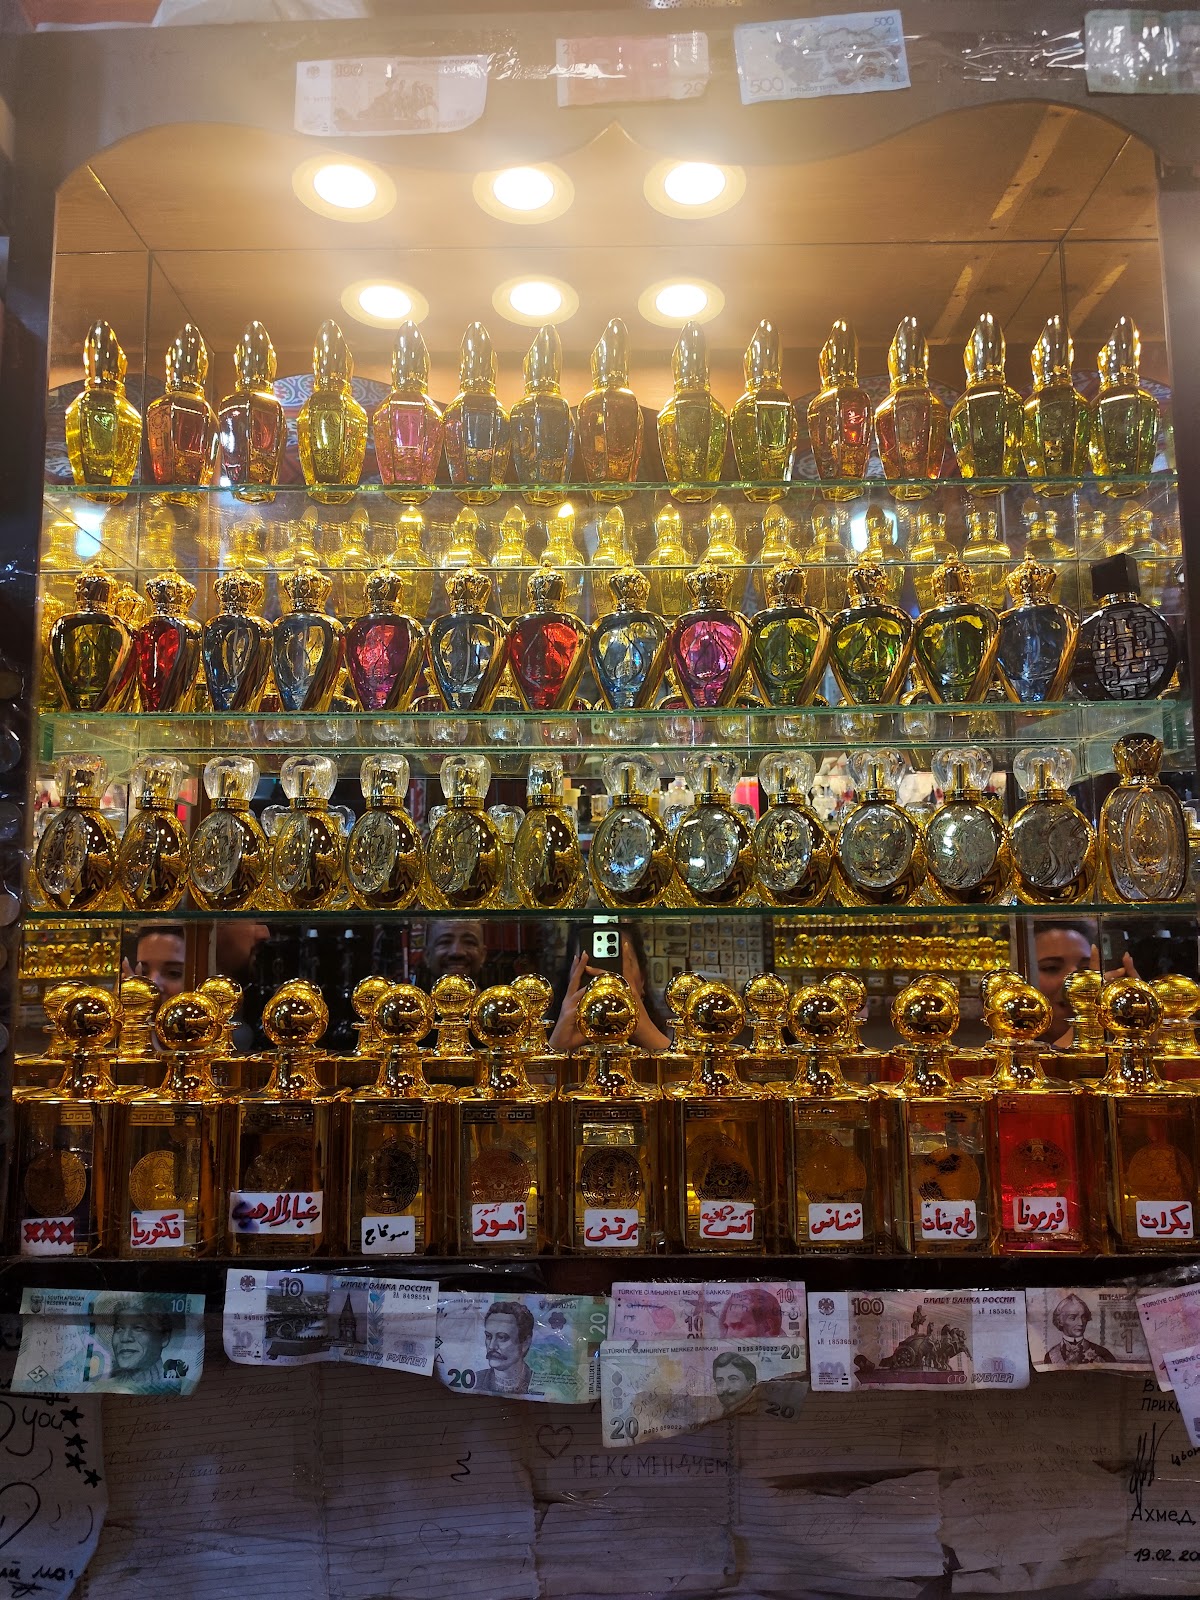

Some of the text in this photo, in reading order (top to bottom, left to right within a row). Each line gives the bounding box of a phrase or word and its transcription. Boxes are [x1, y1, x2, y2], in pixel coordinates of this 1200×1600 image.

[873, 16, 894, 26] 500
[562, 43, 579, 55] 20
[335, 63, 362, 77] 100
[683, 82, 704, 96] 20
[749, 78, 785, 94] 500
[279, 1276, 304, 1297] 10
[399, 1284, 433, 1293] РОССИИ
[618, 1288, 643, 1297] TÜRKİYE
[643, 1288, 681, 1297] CUMHURİYET
[682, 1289, 704, 1297] MERK
[776, 1288, 795, 1304] 10
[982, 1296, 1017, 1305] РОССИИ
[1142, 1297, 1168, 1309] TÜRKİYE
[171, 1299, 185, 1313] 10
[851, 1297, 884, 1317] 100
[590, 1312, 607, 1335] 20
[685, 1315, 703, 1333] 10
[1120, 1328, 1134, 1355] 1
[608, 1347, 632, 1356] TÜRKİYE
[632, 1347, 670, 1355] CUMHURİYET
[671, 1345, 694, 1353] MERKEZ
[780, 1344, 800, 1360] 20
[386, 1352, 428, 1368] РУБЛЕЙ
[1171, 1354, 1196, 1366] TÜRKİYE
[447, 1369, 476, 1389] 20
[947, 1373, 1015, 1384] СТО РУБЛЕЙ
[766, 1401, 796, 1419] 20
[609, 1416, 639, 1440] 20
[573, 1453, 729, 1479] РЕКОМЕНДУЕМ
[1130, 1503, 1197, 1526] Ахмед
